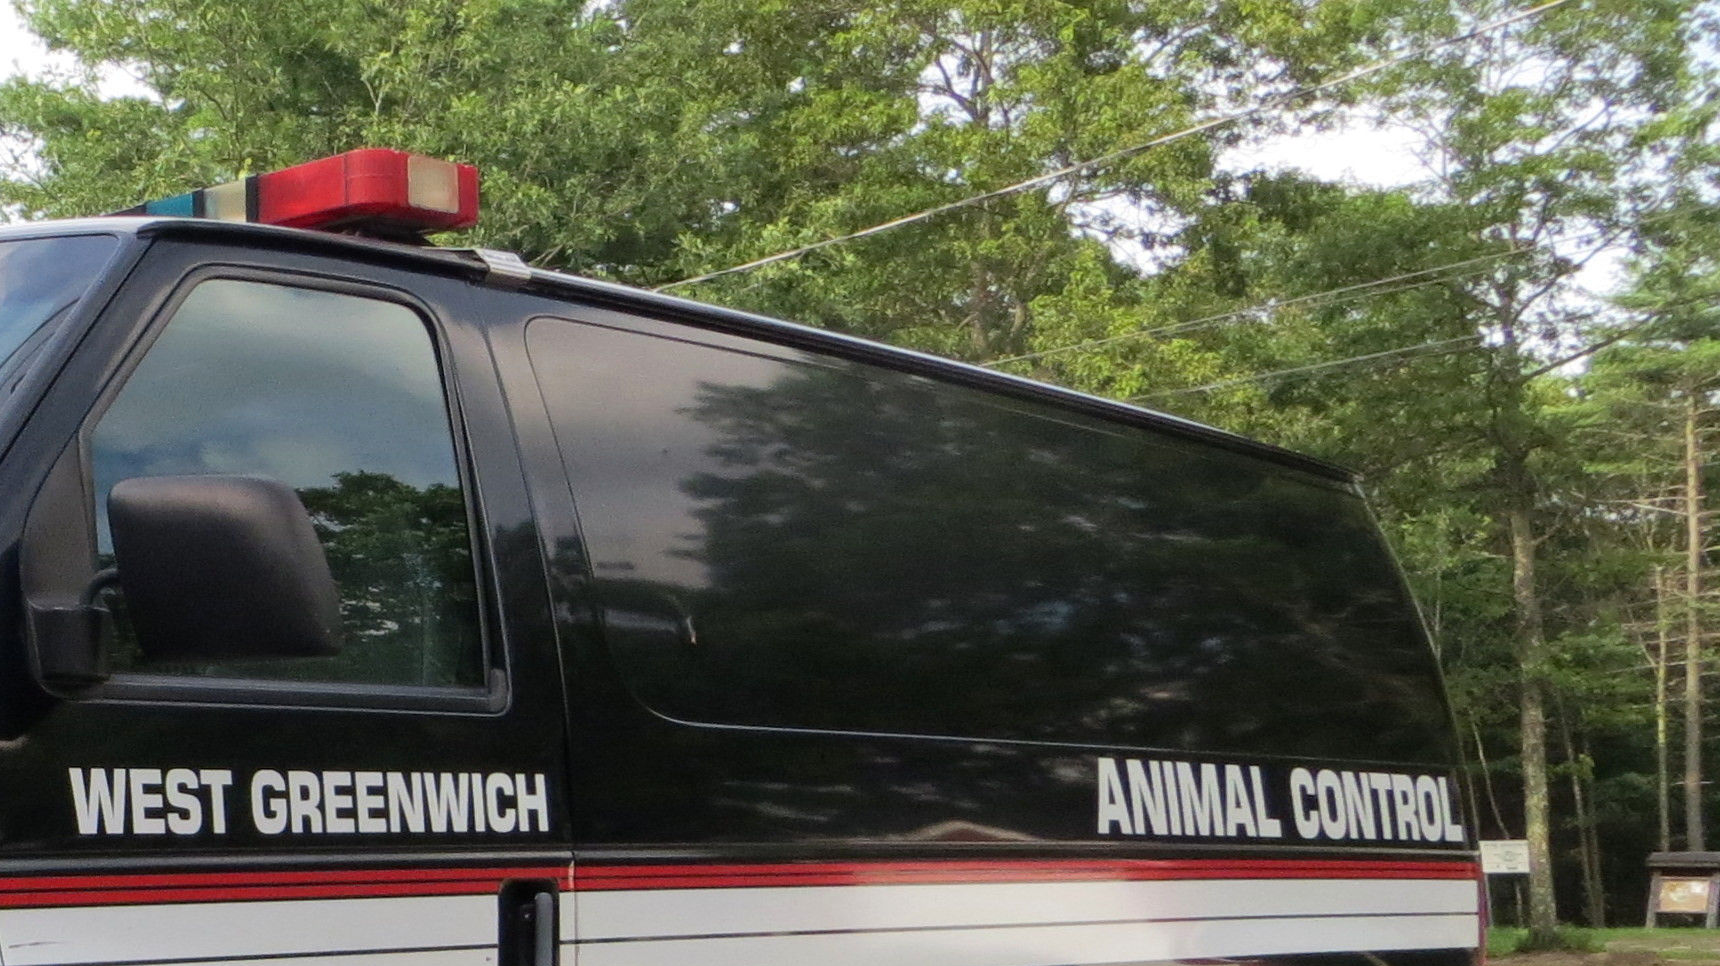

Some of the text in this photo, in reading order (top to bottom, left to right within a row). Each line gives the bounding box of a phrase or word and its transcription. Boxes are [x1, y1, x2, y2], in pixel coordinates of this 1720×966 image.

[69, 767, 549, 835] WEST GREENWICH
[1097, 757, 1463, 842] ANIMAL CONTROL
